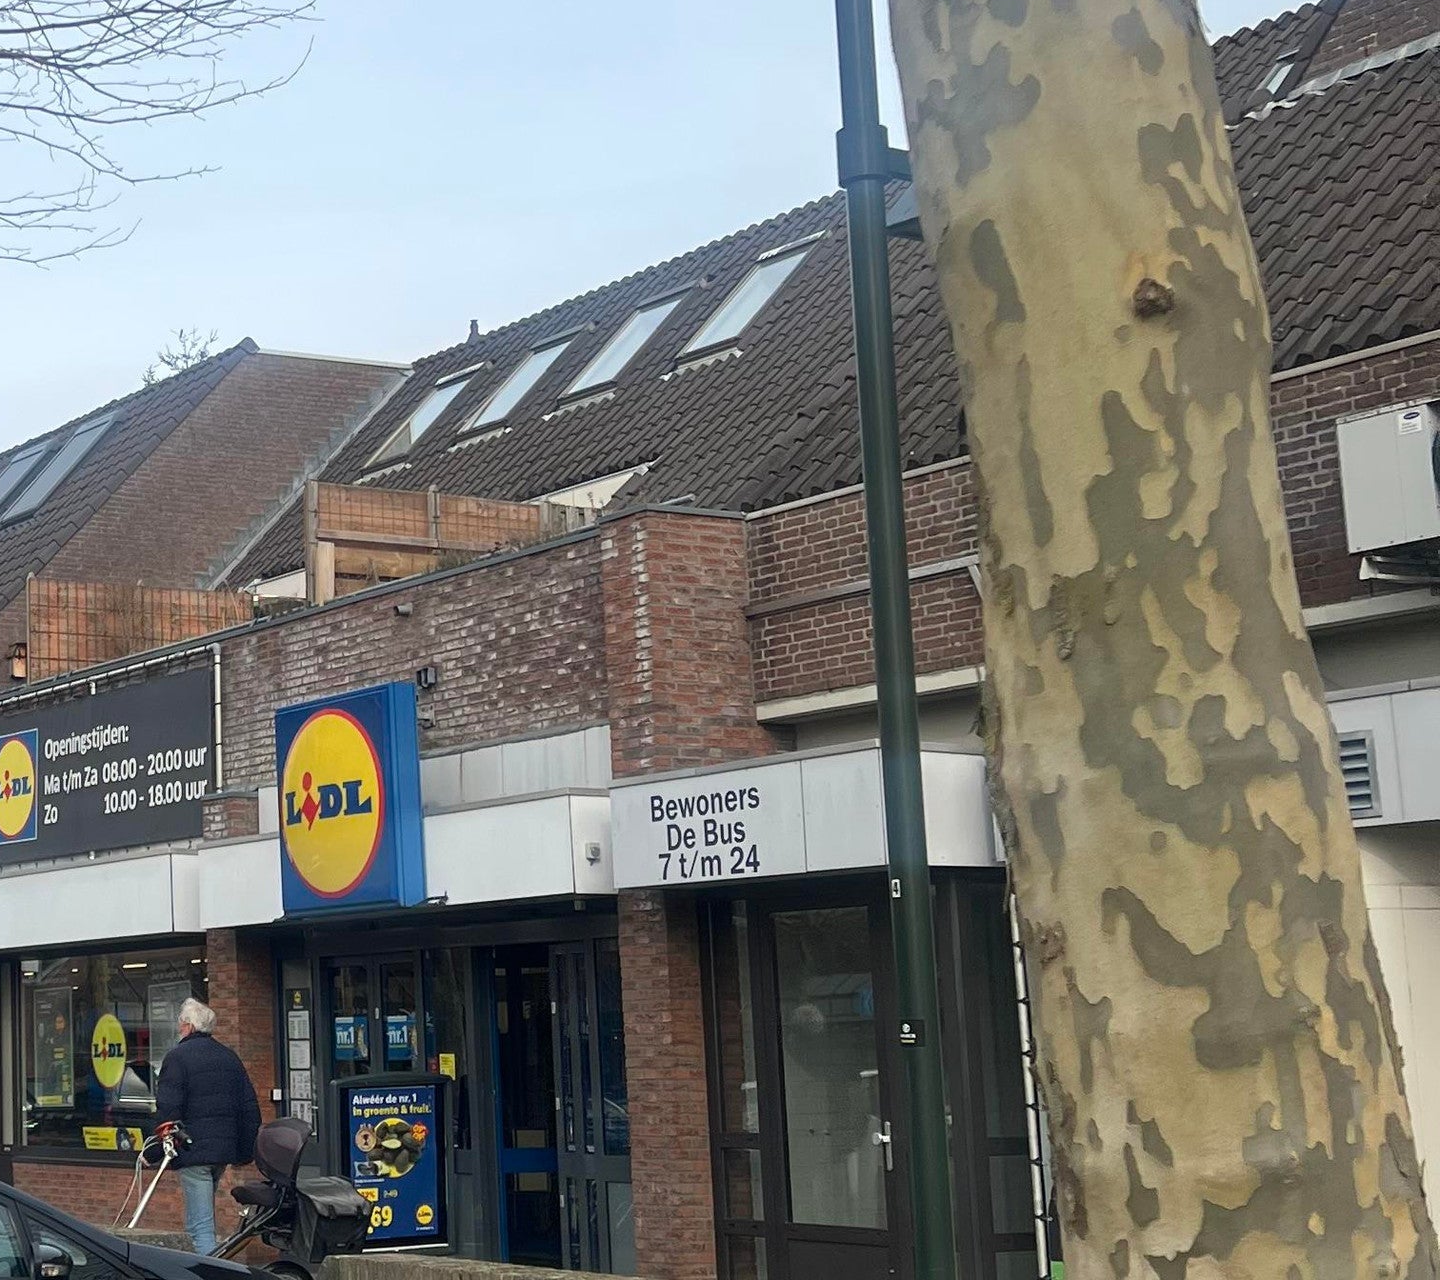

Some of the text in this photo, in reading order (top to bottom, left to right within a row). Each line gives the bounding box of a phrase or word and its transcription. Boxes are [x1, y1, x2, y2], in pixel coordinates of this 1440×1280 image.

[44, 724, 130, 762] Openingstijden:
[44, 774, 60, 795] Ma
[62, 769, 82, 794] t/m
[83, 766, 98, 788] Za
[102, 757, 137, 784] 08.00
[147, 748, 182, 776] 20.00
[184, 746, 208, 769] uur
[43, 803, 59, 825] Zo
[103, 788, 137, 814] 10.00
[148, 780, 182, 807] 18.00
[185, 779, 208, 801] uur
[650, 787, 760, 822] Bewoners
[667, 819, 746, 851] De Bus
[658, 844, 760, 880] 7 t/m 24
[385, 1093, 398, 1104] de
[412, 1093, 417, 1102] 1
